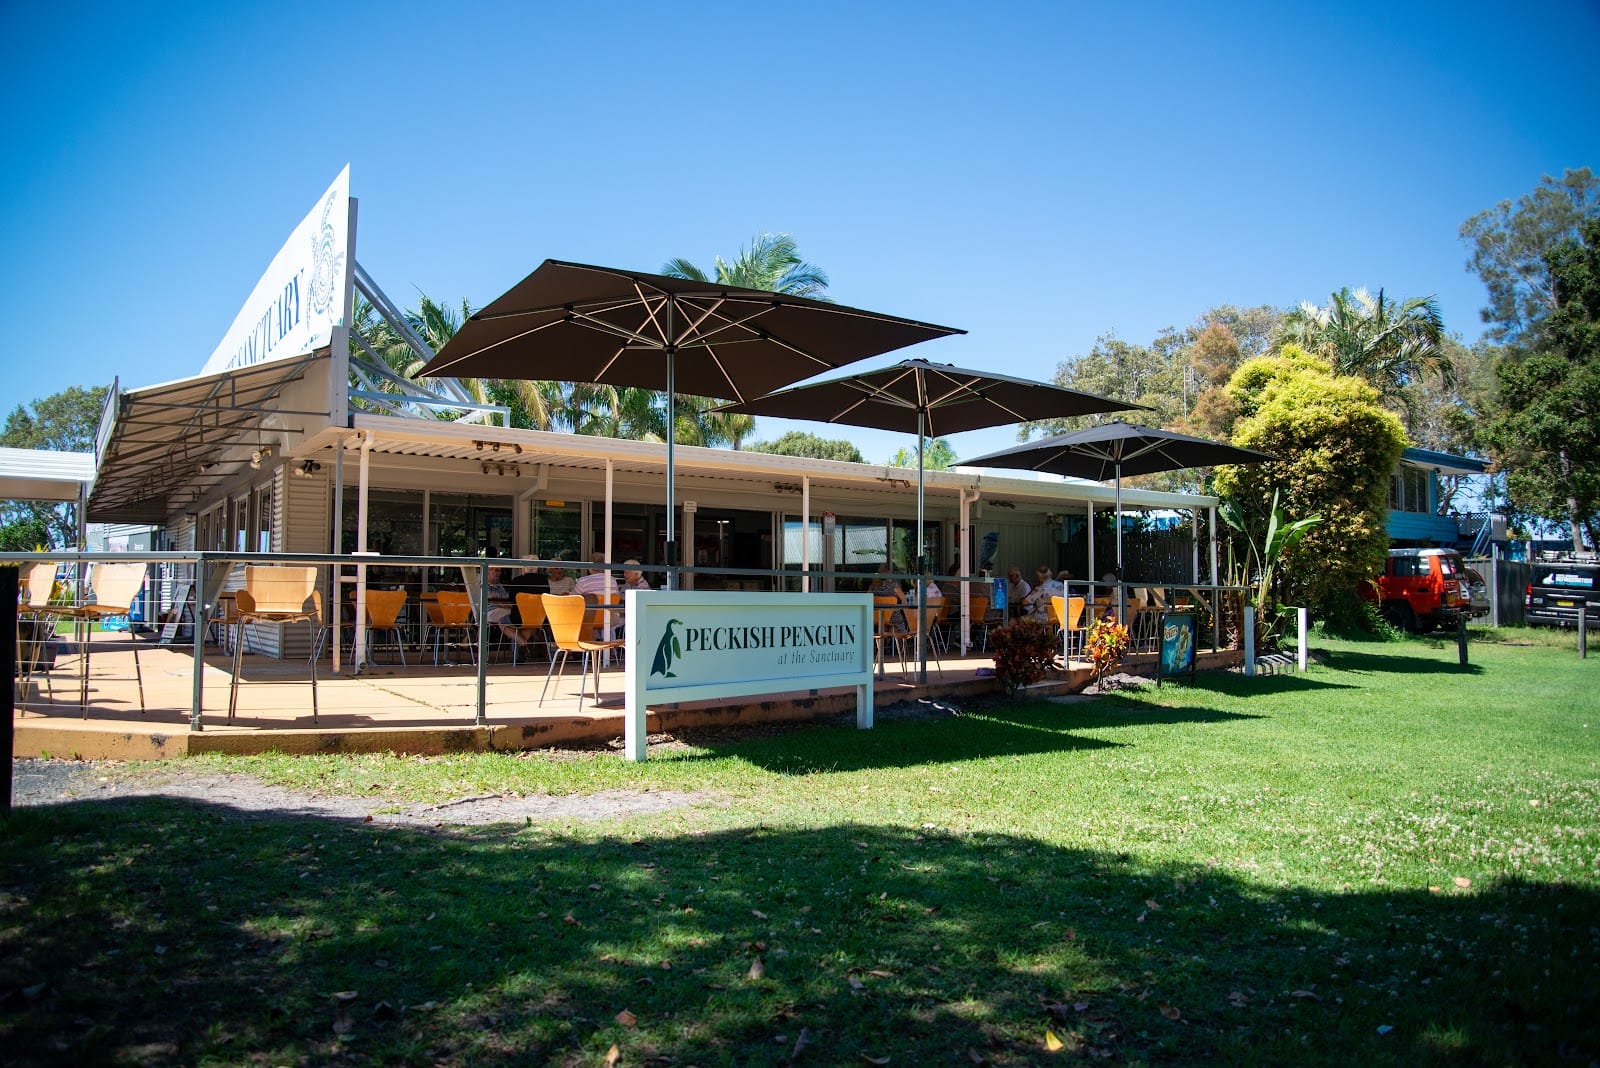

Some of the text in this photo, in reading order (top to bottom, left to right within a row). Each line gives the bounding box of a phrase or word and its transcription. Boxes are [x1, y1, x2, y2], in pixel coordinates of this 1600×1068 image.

[685, 624, 856, 652] PECKISH PENGUIN
[777, 649, 855, 665] at the Sanctuary
